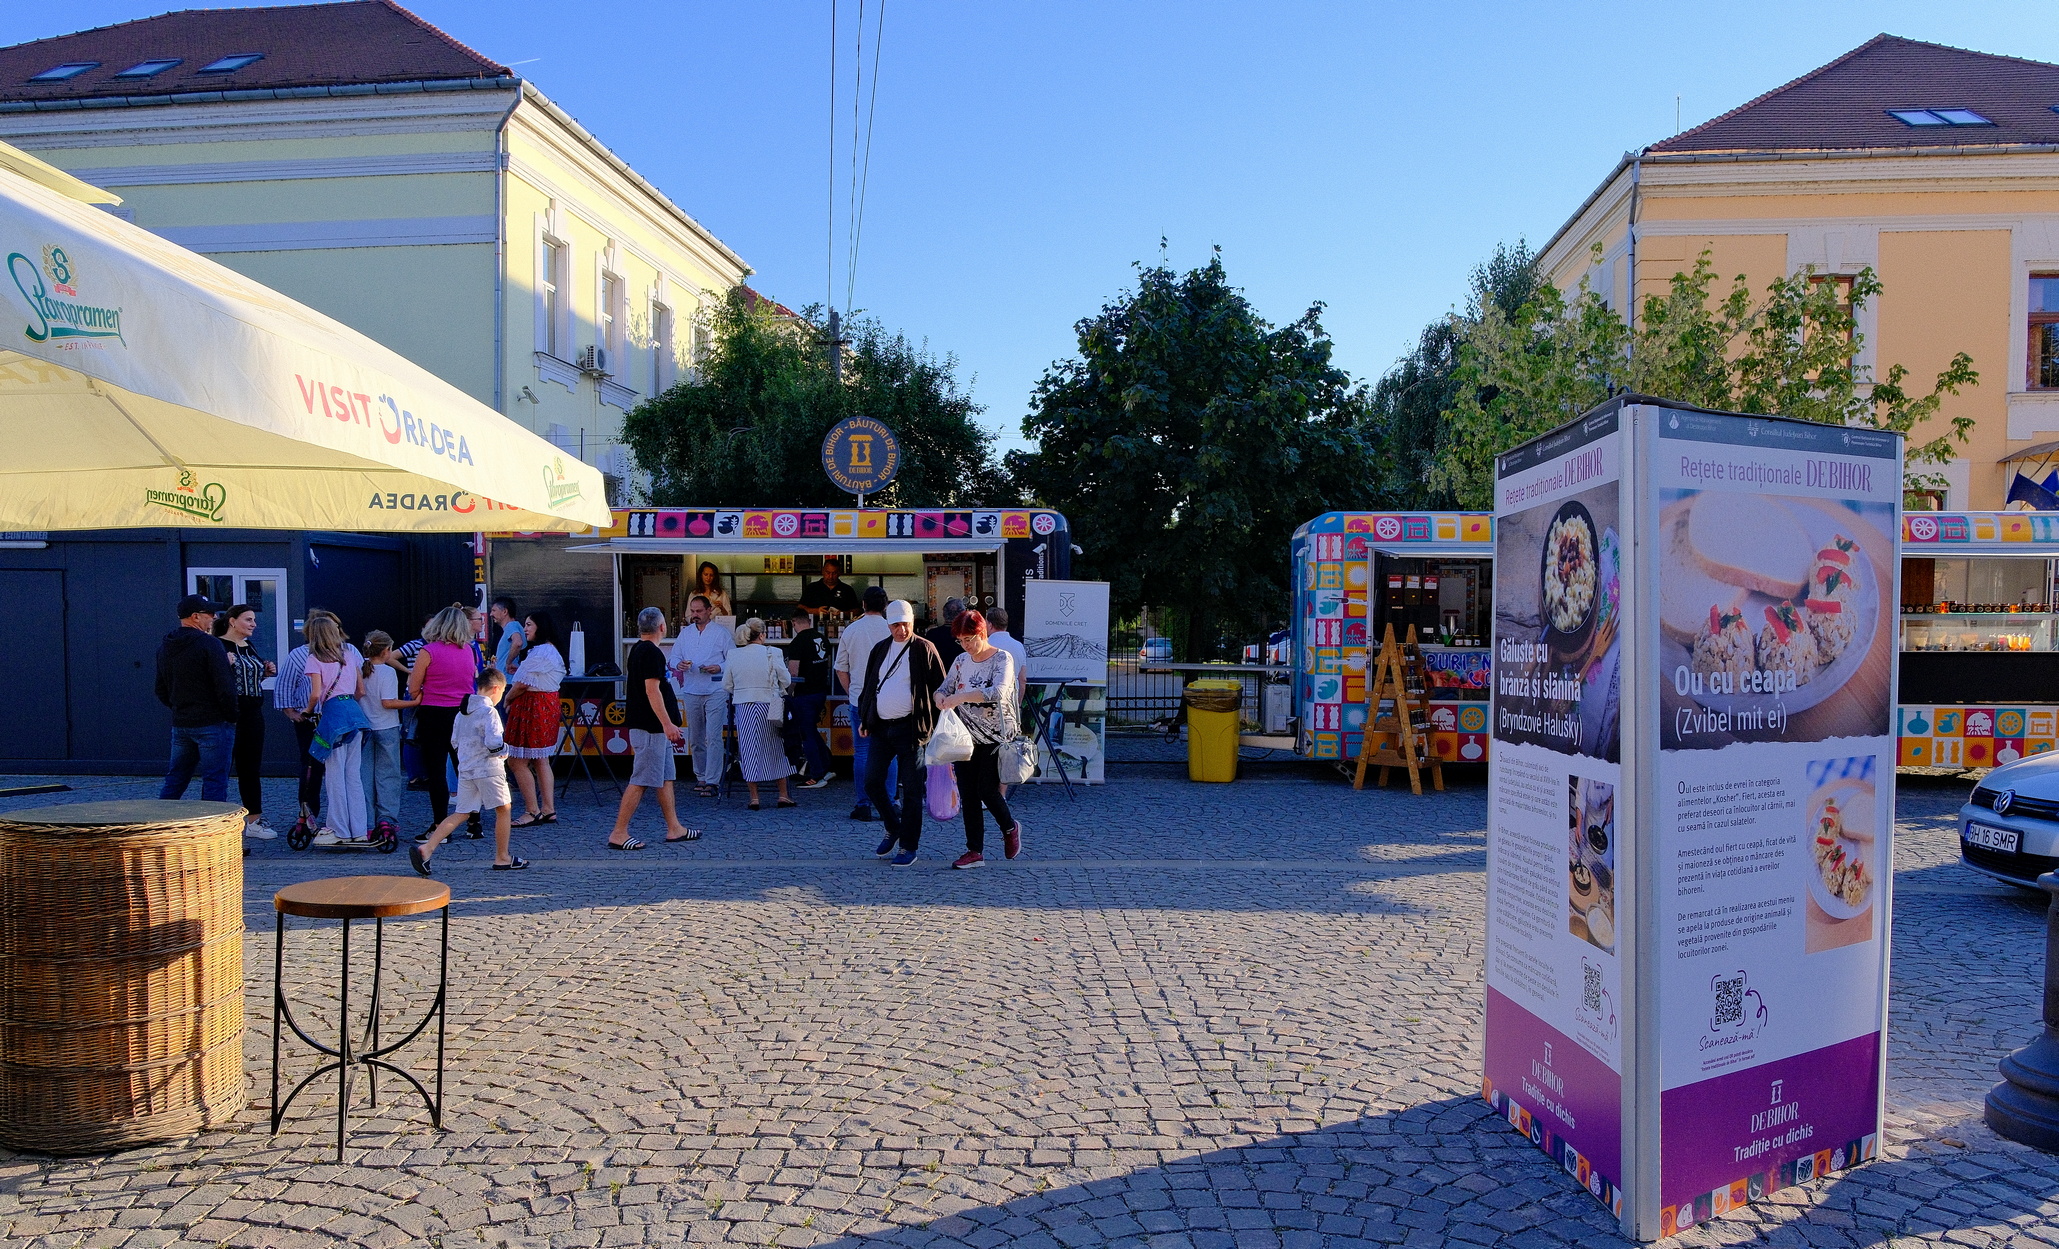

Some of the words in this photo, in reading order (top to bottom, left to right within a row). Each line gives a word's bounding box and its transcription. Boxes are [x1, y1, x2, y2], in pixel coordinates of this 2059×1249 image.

[7, 252, 121, 343] Staropramen
[295, 374, 371, 428] VISIT
[849, 418, 889, 438] BĂUTURI
[826, 428, 844, 455] BIHOR
[885, 438, 896, 451] DE
[826, 457, 836, 470] DE
[878, 453, 896, 480] BIHOR
[1681, 456, 1724, 484] Rețete
[1728, 461, 1802, 488] tradiționale
[1506, 486, 1524, 507] Rețete
[1526, 470, 1562, 500] tradiționale
[1500, 637, 1534, 670] Găluște
[1536, 643, 1548, 663] cu
[1500, 670, 1529, 698] brânză
[1532, 673, 1541, 706] și
[1543, 672, 1581, 701] slănină
[1675, 665, 1703, 697] Ou
[1710, 671, 1733, 694] cu
[1740, 660, 1797, 700] ceapă
[1500, 706, 1542, 735] (Bryndzové
[1544, 712, 1583, 746] Halušky)
[1675, 706, 1732, 742] (Zvibel
[1738, 705, 1763, 730] mit
[1768, 702, 1787, 735] ei)
[1678, 780, 1691, 795] Oul
[1693, 785, 1705, 793] este
[1707, 782, 1724, 792] inclus
[1725, 780, 1733, 790] de
[1734, 779, 1748, 789] evrei
[1748, 779, 1754, 788] în
[1755, 777, 1781, 788] categoria
[1678, 796, 1712, 808] alimentelor
[1742, 792, 1757, 802] Fiert,
[1758, 790, 1775, 799] acesta
[1678, 810, 1702, 821] preferat
[1703, 807, 1724, 817] deseori
[1733, 803, 1760, 814] înlocuitor
[1761, 802, 1767, 811] al
[1785, 800, 1796, 808] mai
[1686, 821, 1706, 832] seamă
[1707, 820, 1713, 829] în
[1714, 818, 1729, 828] cazul
[1730, 816, 1757, 826] salatelor.
[1678, 845, 1714, 858] Amestecând
[1715, 843, 1724, 853] oul
[1726, 841, 1738, 851] fiert
[1746, 839, 1764, 850] ceapă,
[1765, 837, 1778, 847] ficat
[1778, 836, 1785, 845] de
[1982, 829, 1991, 844] 16
[1993, 831, 2016, 850] SMR
[1684, 858, 1714, 869] maioneză
[1722, 854, 1744, 866] obținea
[1750, 851, 1774, 861] mâncare
[1775, 849, 1784, 858] des
[1678, 872, 1704, 885] prezentă
[1705, 870, 1711, 879] în
[1712, 868, 1726, 879] viața
[1727, 864, 1754, 876] cotidiană
[1759, 862, 1780, 872] evreilor
[1678, 884, 1705, 896] bihoreni.
[1678, 912, 1686, 922] De
[1687, 909, 1714, 920] remarcat
[1714, 906, 1721, 916] că
[1722, 905, 1728, 914] în
[1729, 902, 1757, 913] realizarea
[1758, 899, 1777, 909] acestui
[1778, 896, 1795, 905] meniu
[1687, 923, 1703, 934] apela
[1704, 922, 1710, 930] la
[1711, 918, 1734, 930] produse
[1736, 916, 1743, 924] de
[1744, 913, 1764, 924] origine
[1764, 908, 1786, 919] animală
[1678, 935, 1703, 948] vegetală
[1704, 930, 1732, 943] provenite
[1733, 928, 1742, 937] din
[1743, 922, 1777, 937] gospodăriile
[1678, 946, 1710, 959] locuitorilor
[1711, 942, 1728, 953] zonei.
[1522, 1076, 1545, 1106] Tradiție
[1546, 1098, 1554, 1113] cu
[1556, 1102, 1575, 1130] dichis
[1734, 1139, 1770, 1162] Tradiție
[1772, 1137, 1784, 1149] cu
[1786, 1122, 1814, 1144] dichis
